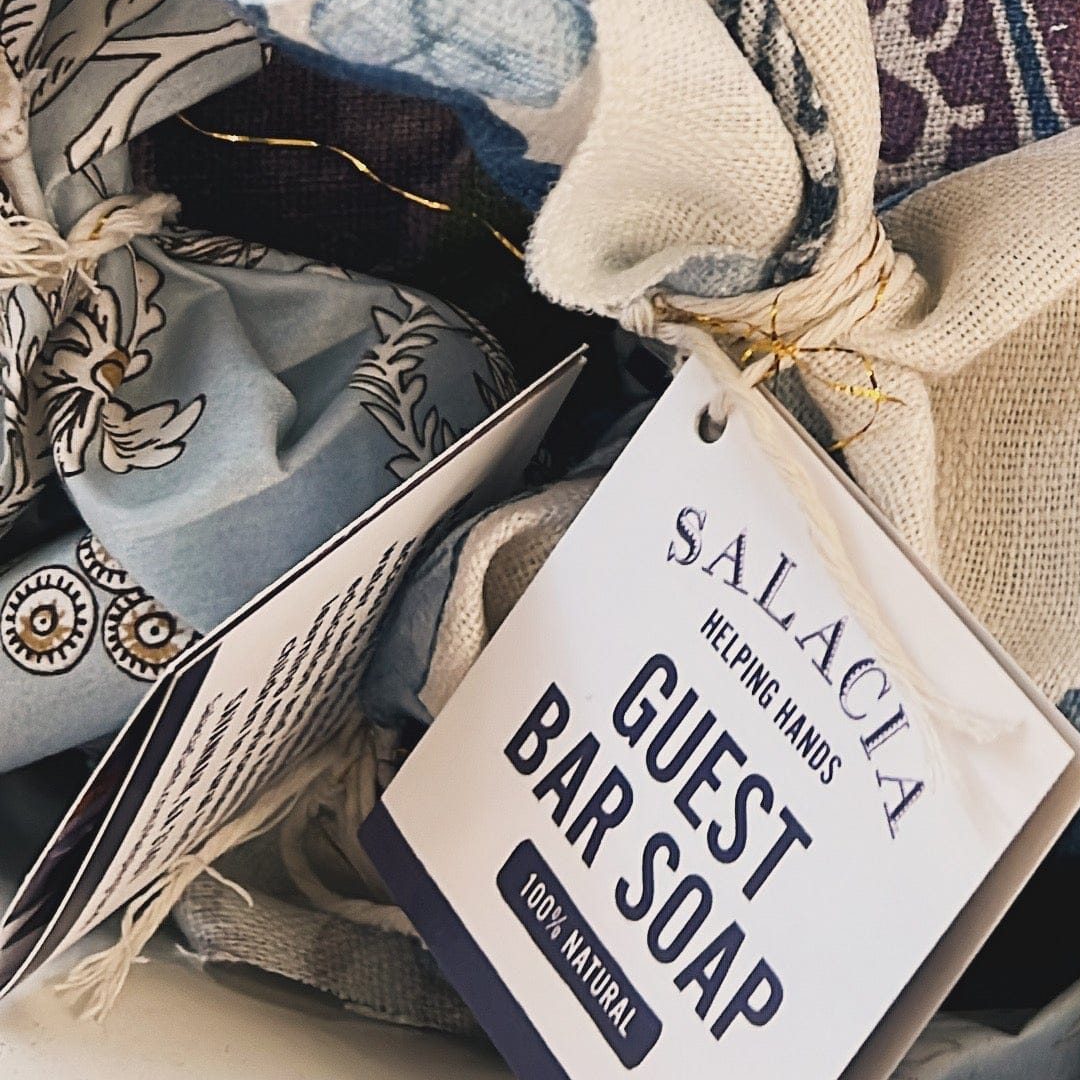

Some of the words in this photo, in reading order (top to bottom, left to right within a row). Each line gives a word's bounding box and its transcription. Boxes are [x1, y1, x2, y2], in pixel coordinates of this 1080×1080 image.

[613, 653, 813, 901] GUEST
[666, 506, 925, 840] SALACIA
[700, 607, 781, 710] HELPING
[773, 697, 842, 785] HANDS
[503, 682, 634, 869] BAR
[614, 832, 784, 1041] SOAP
[518, 872, 568, 941] 100%
[560, 928, 638, 1039] NATURAL
